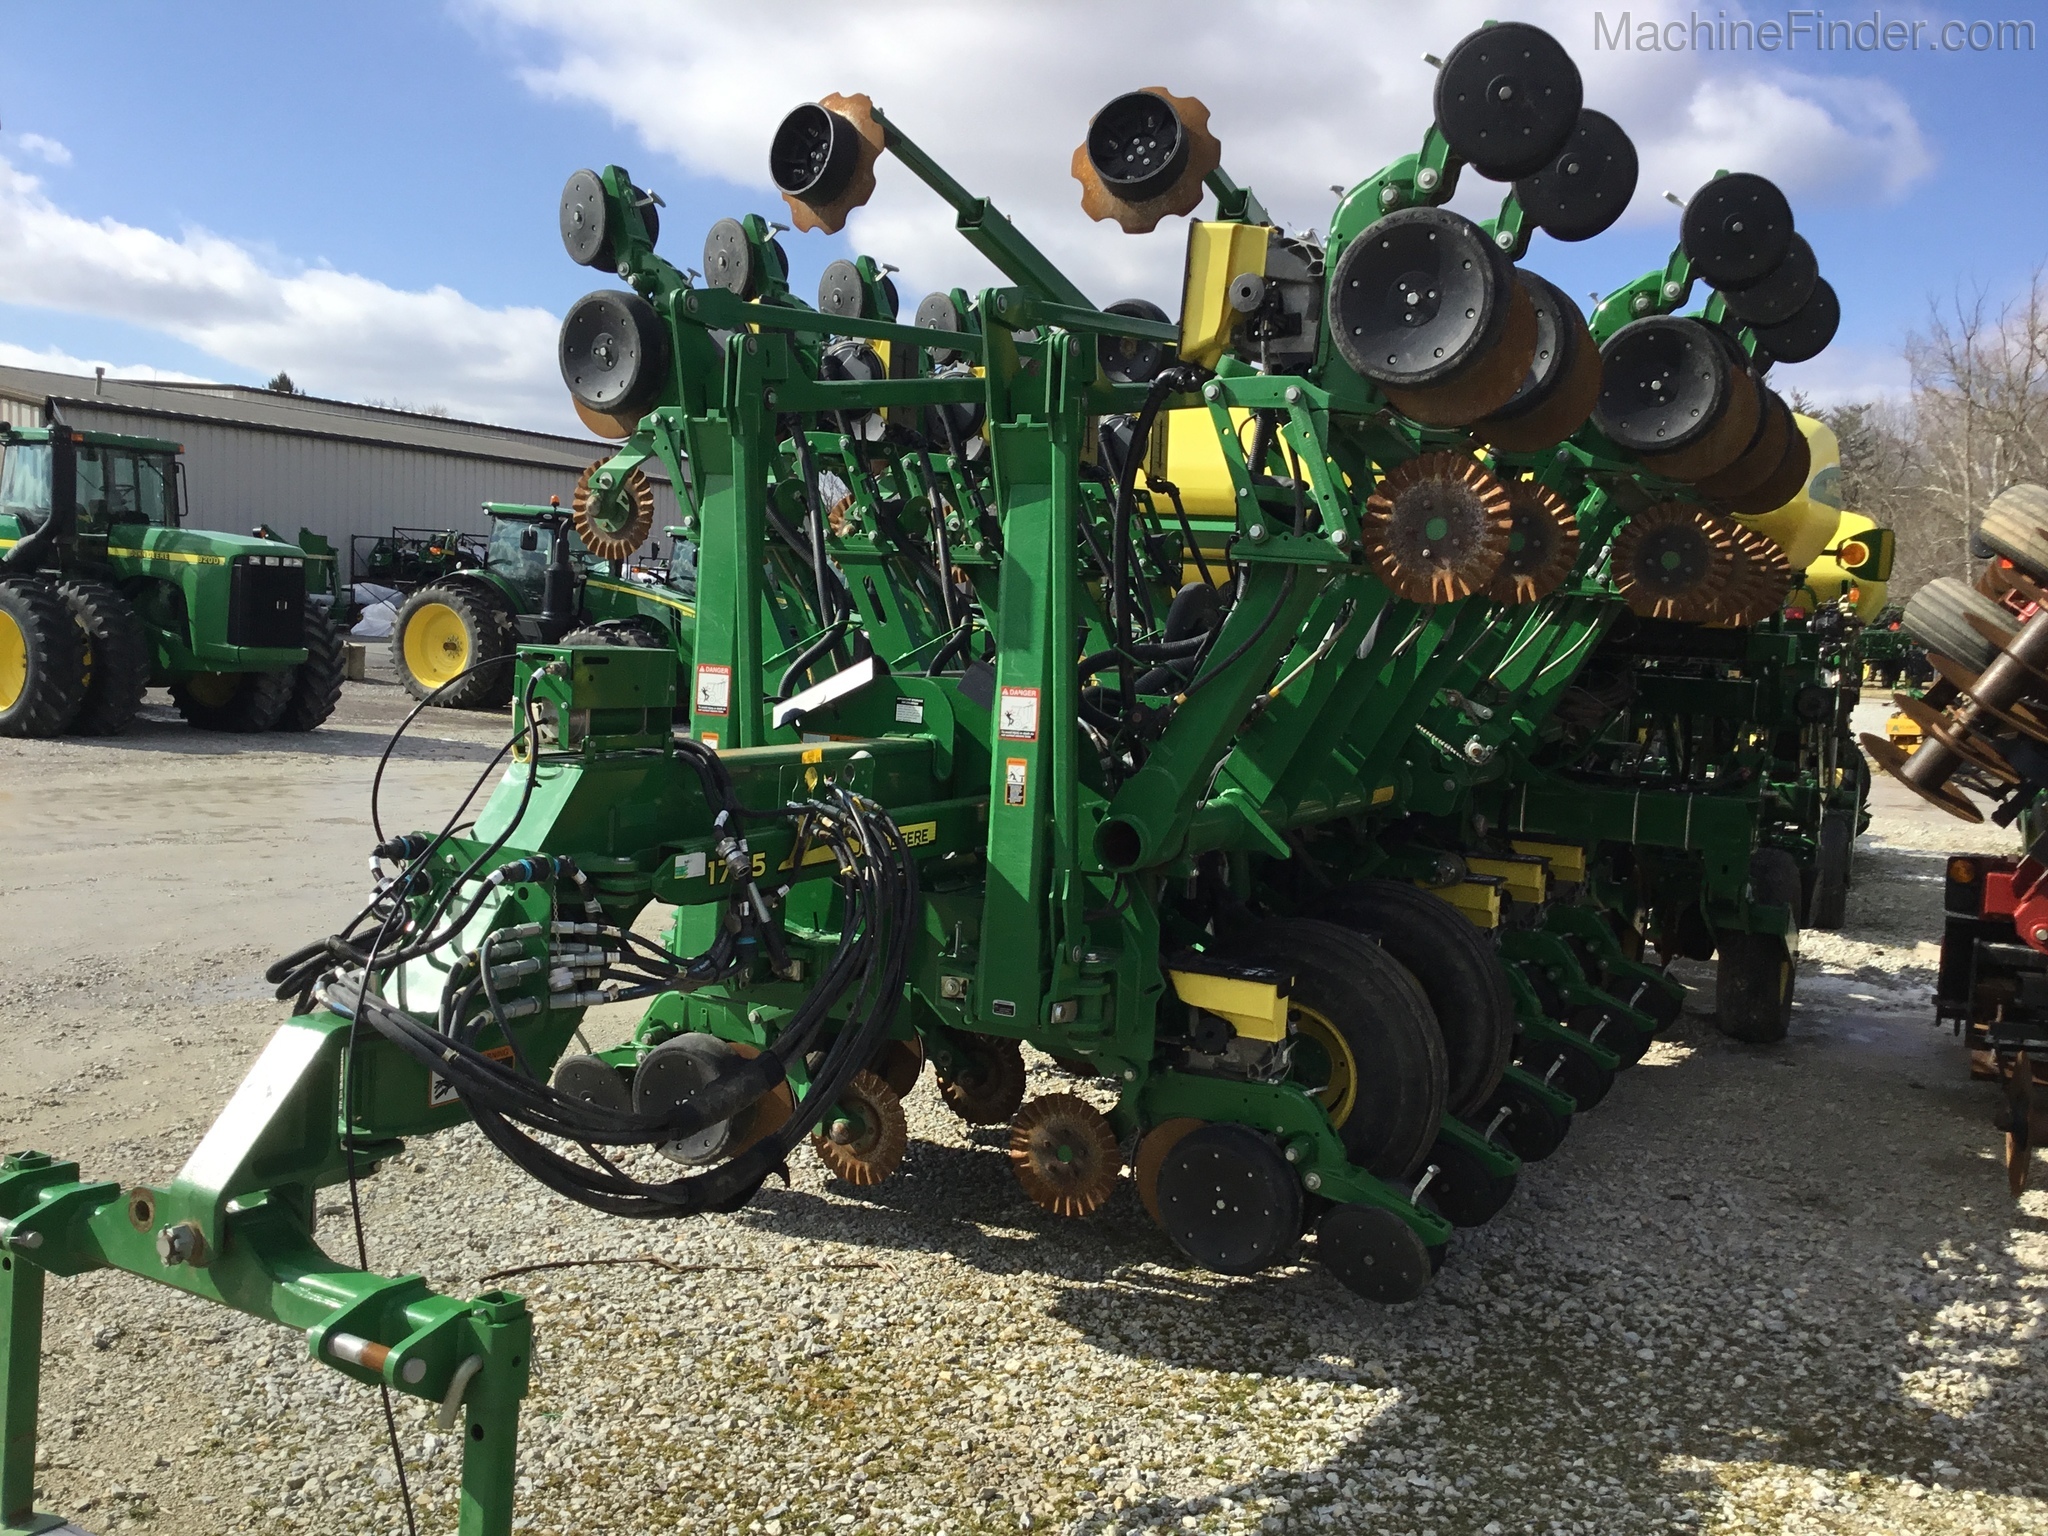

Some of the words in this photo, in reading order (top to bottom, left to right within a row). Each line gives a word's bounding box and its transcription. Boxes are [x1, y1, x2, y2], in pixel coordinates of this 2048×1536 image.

[147, 550, 169, 560] DEERE
[1009, 688, 1036, 697] DANGER
[708, 852, 766, 885] 175
